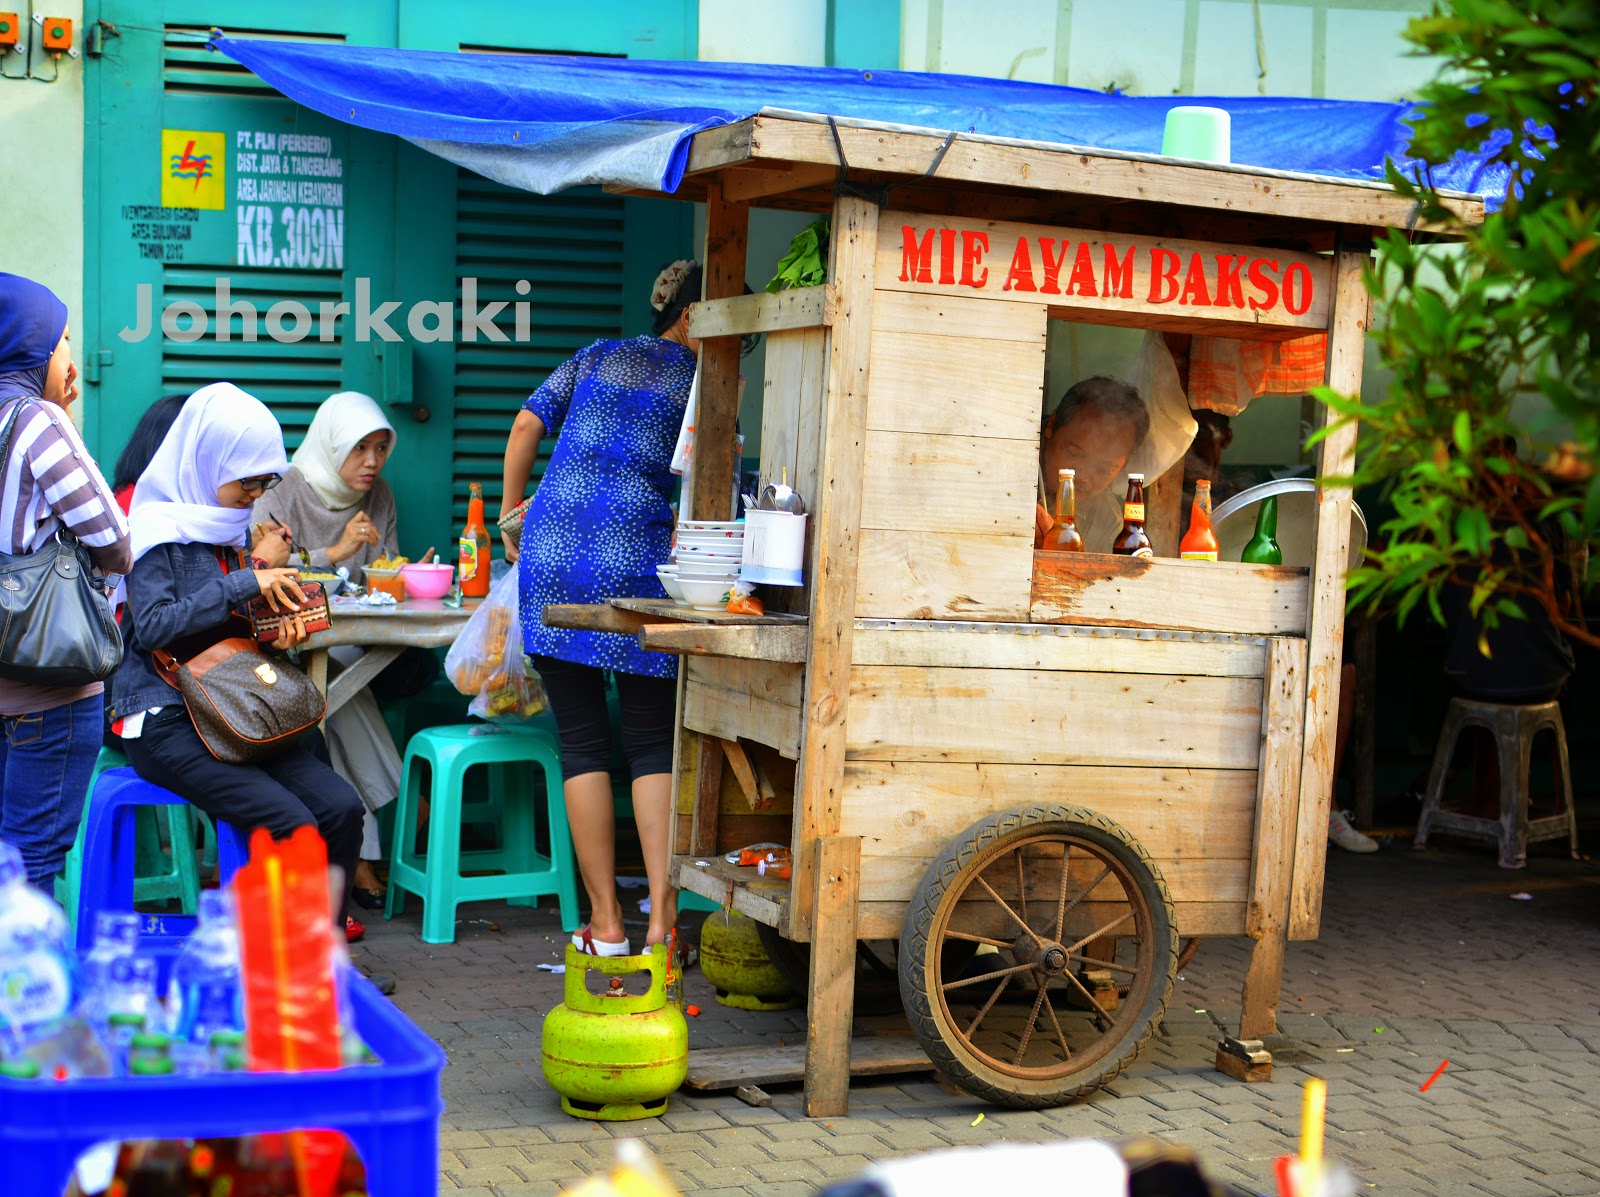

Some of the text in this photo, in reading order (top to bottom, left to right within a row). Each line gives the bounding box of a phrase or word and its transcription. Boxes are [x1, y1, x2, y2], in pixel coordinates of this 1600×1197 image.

[237, 131, 332, 156] PT. PLN (PERSERO)
[237, 153, 343, 178] DIST. JAYA & TANGERANG
[237, 178, 343, 207] AREA JARINGAN KEBAYORAN
[131, 223, 192, 241] AREA BULUNGAN
[237, 205, 344, 269] KB.309N
[139, 243, 164, 260] TAHUN
[899, 225, 1314, 316] MIE AYAM BAKSO
